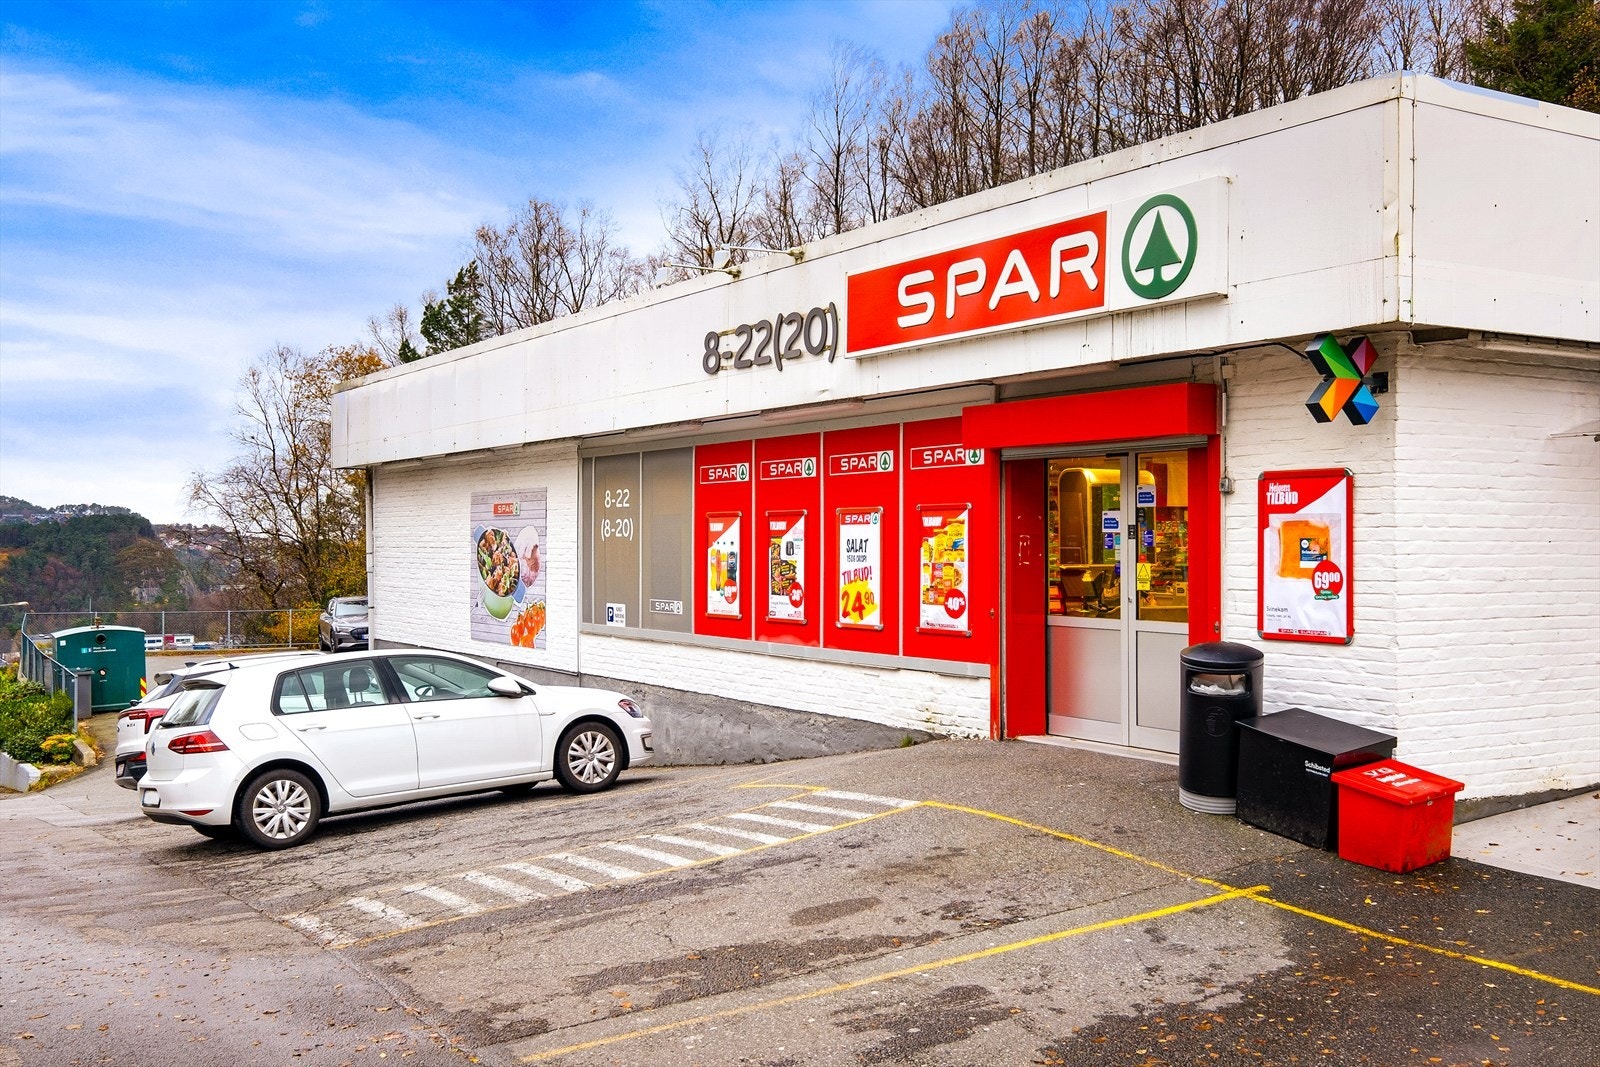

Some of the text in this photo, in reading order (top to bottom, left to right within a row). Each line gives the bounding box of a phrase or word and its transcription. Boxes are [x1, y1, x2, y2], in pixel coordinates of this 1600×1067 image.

[896, 229, 1100, 329] SPAR
[702, 301, 838, 375] 8-22(20)
[840, 454, 877, 471] SPAR
[923, 449, 965, 465] SPAR
[708, 465, 737, 480] SPAR
[769, 460, 802, 476] SPAR
[604, 488, 630, 508] 8-22
[1266, 491, 1298, 505] TILBUD
[497, 504, 514, 513] SPAR
[844, 513, 871, 525] SPAR
[600, 517, 634, 541] (8-20)
[846, 538, 869, 553] SALAT
[841, 565, 873, 585] TILBUD!
[655, 601, 675, 611] SPAR
[1304, 760, 1331, 774] Schibsted
